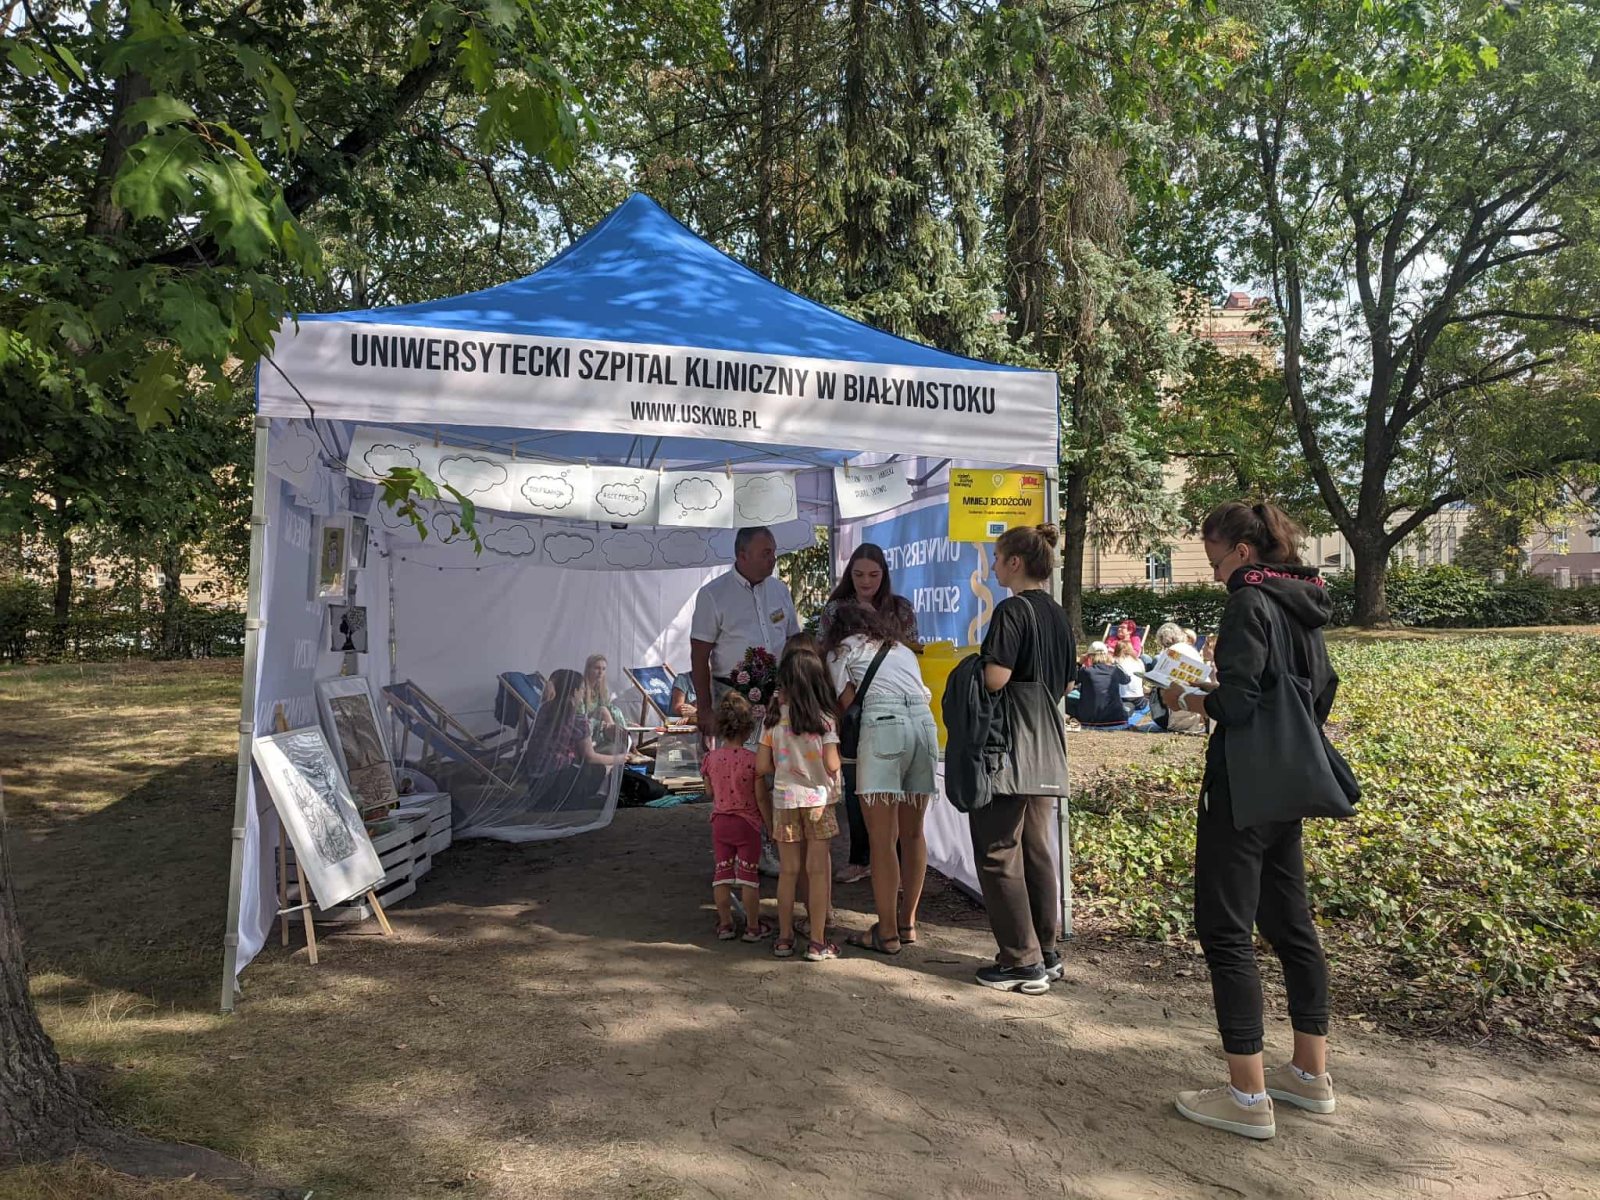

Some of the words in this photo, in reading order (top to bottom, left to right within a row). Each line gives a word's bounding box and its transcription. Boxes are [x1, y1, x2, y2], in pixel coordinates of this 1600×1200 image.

[350, 333, 570, 378] UNIWERSYTECKI
[578, 349, 678, 385] SZPITAL
[685, 356, 808, 397] KLINICZNY
[816, 371, 837, 399] W
[843, 374, 996, 414] BIAŁYMSTOKU
[630, 401, 762, 429] WWW.USKWB.PL
[962, 496, 988, 506] MNIEJ
